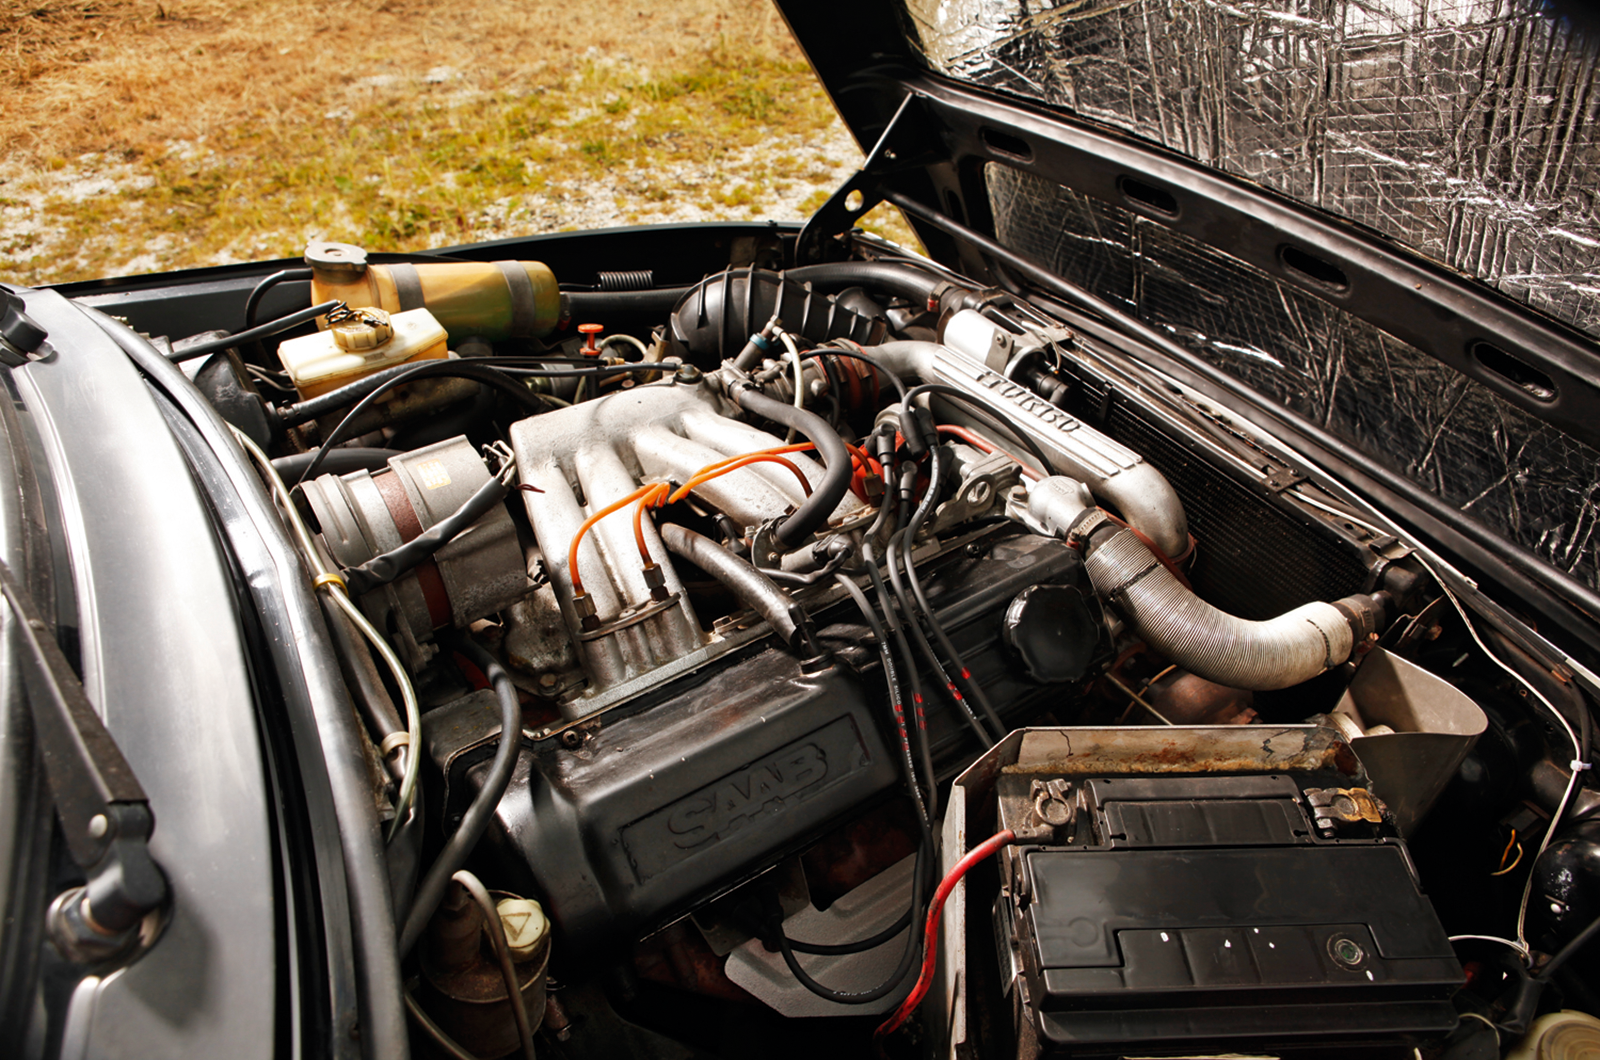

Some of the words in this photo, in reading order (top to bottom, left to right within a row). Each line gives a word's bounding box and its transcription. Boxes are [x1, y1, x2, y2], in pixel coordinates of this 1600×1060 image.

[976, 371, 1081, 432] TURBO
[886, 657, 897, 681] DOUBLE
[667, 742, 828, 850] SAAB
